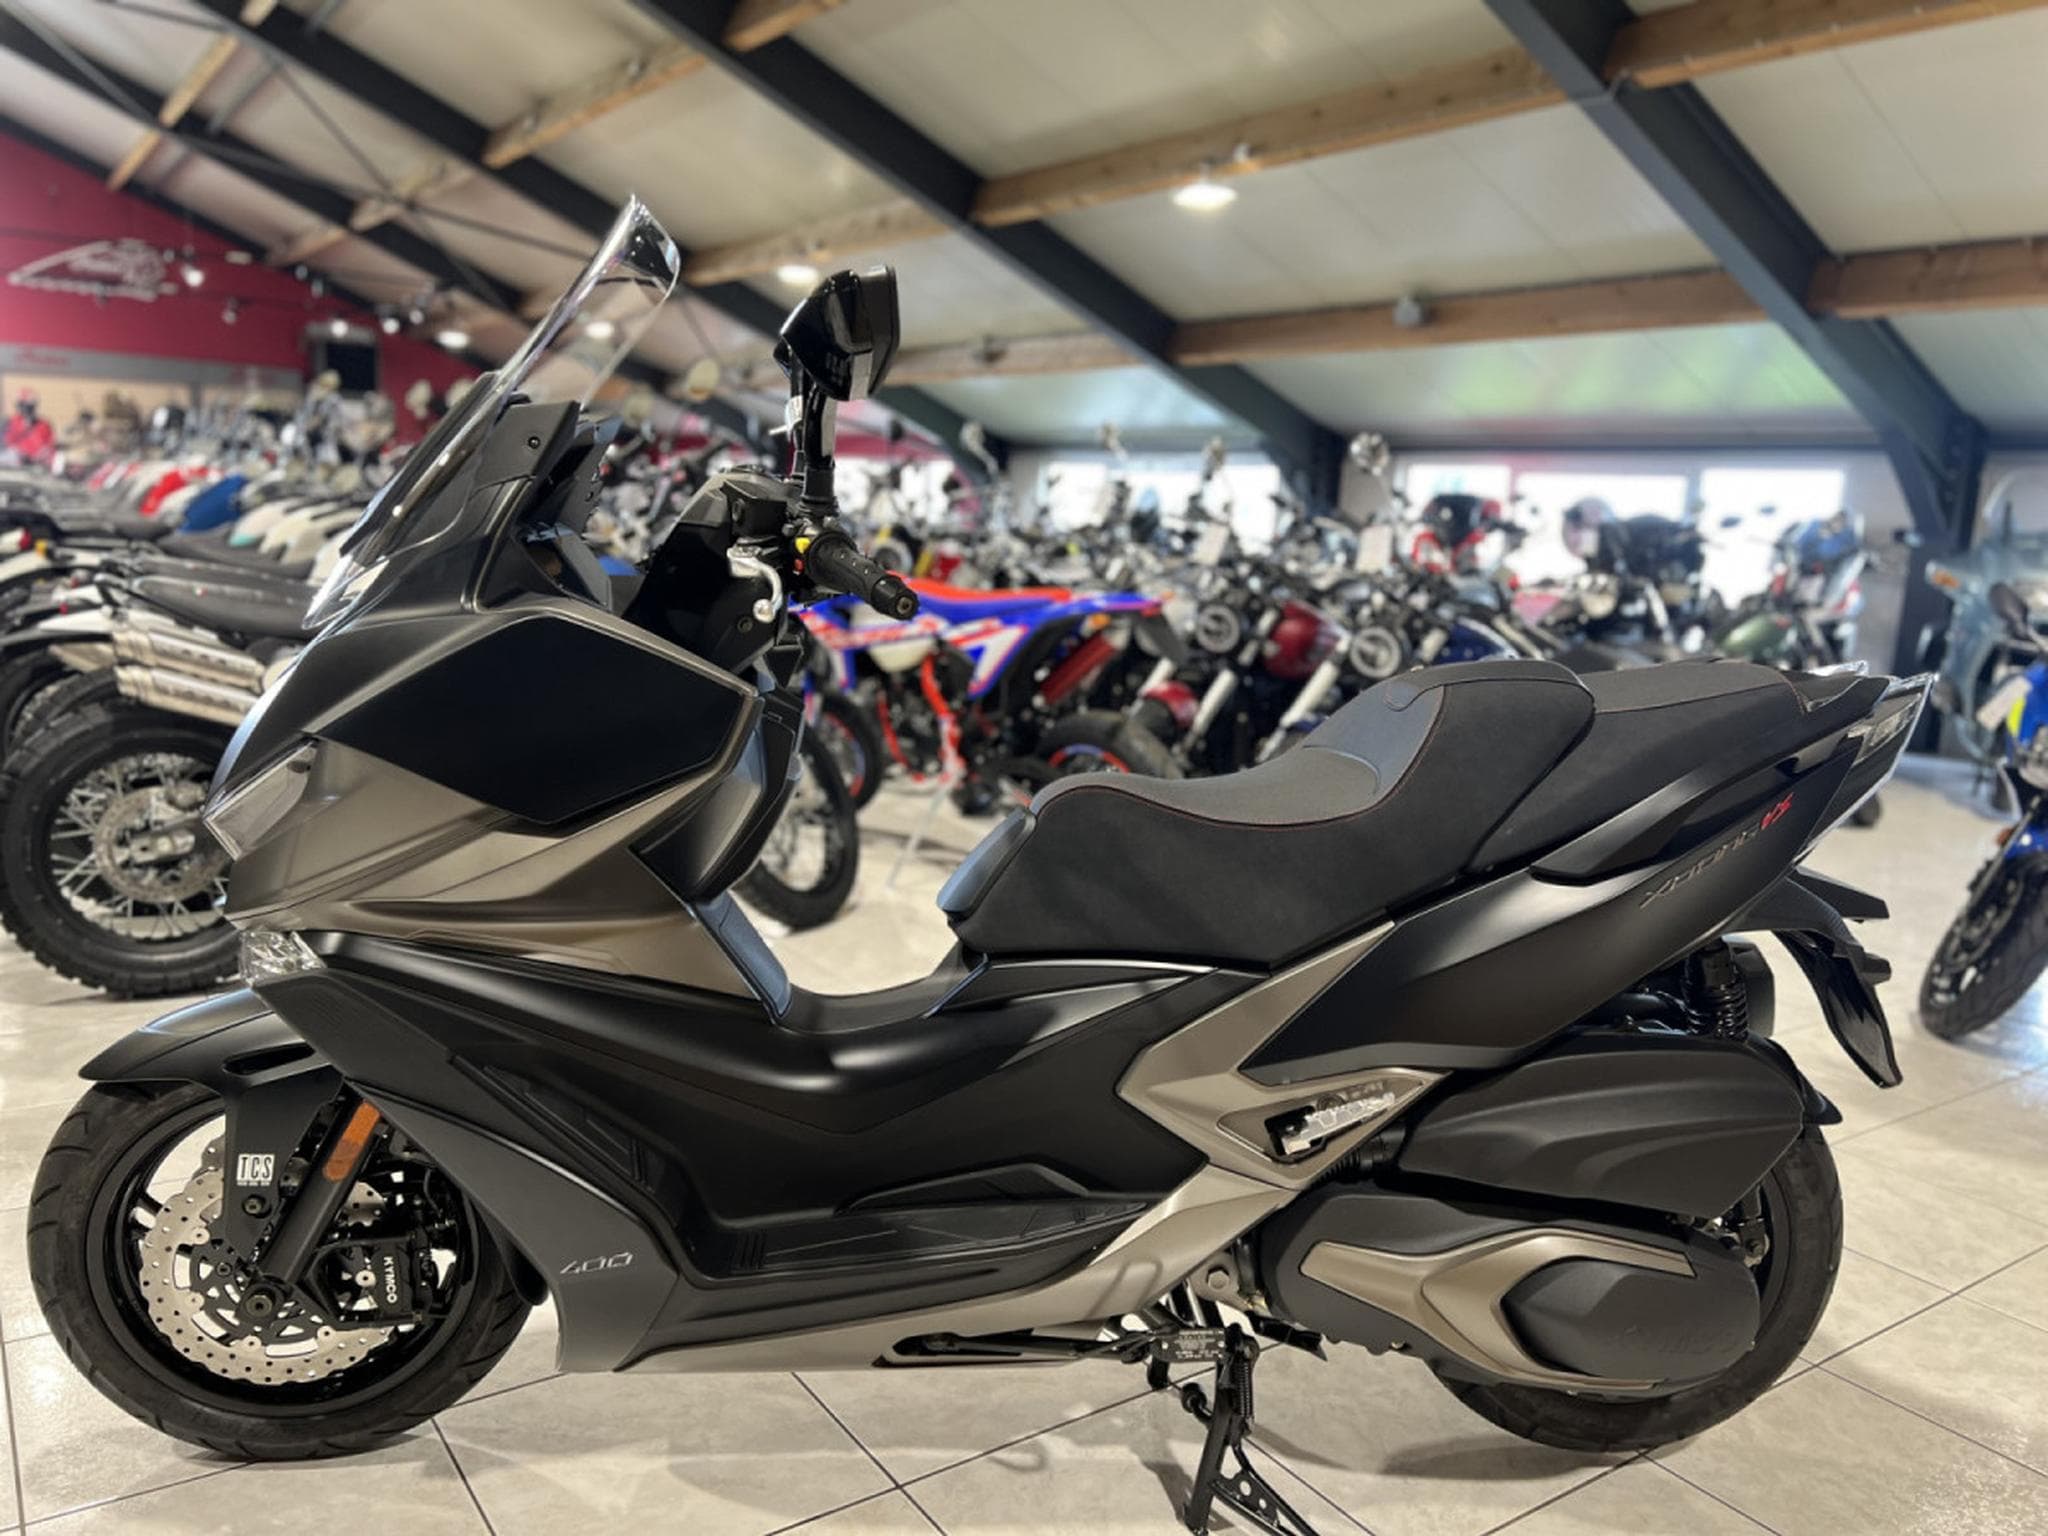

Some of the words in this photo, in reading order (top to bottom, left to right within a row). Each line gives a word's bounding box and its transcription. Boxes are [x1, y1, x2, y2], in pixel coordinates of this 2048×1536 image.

[240, 1155, 273, 1180] TCS
[560, 1252, 633, 1274] 400
[383, 1256, 398, 1304] KYMCO
